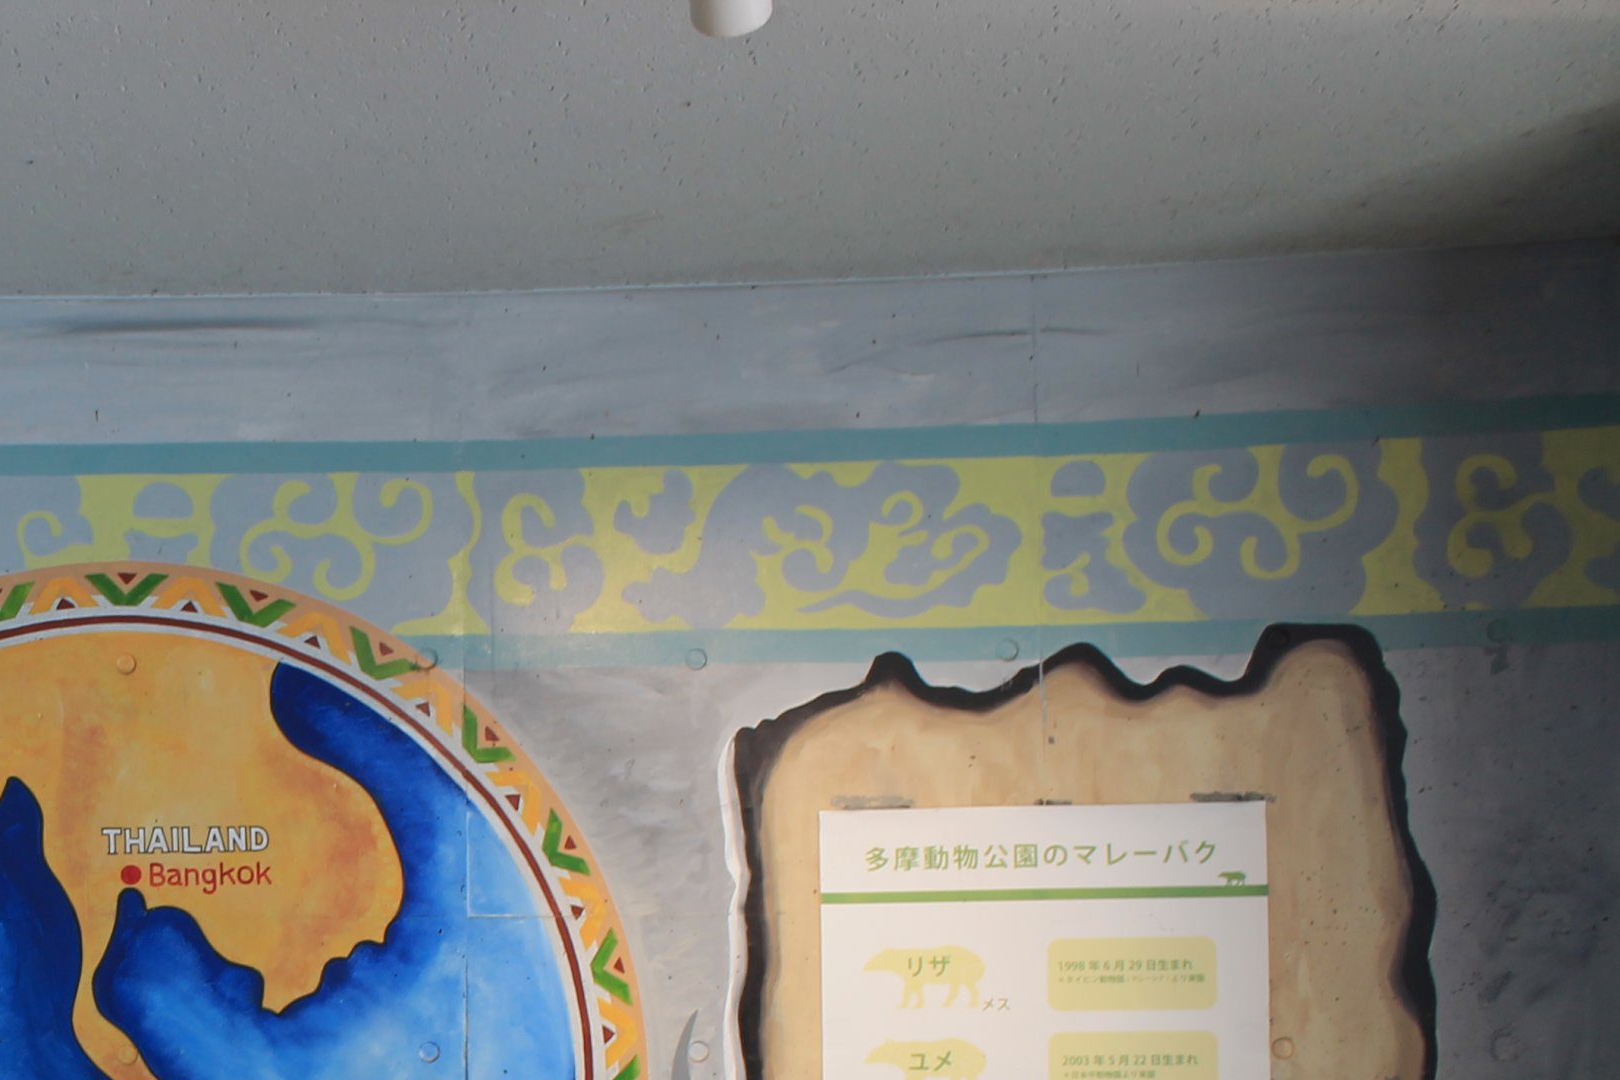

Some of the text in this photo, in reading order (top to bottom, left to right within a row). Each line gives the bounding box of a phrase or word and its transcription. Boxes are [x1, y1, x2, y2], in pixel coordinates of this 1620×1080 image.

[102, 826, 269, 854] THAILAND
[864, 841, 1217, 872] 多摩動物公園のマレーバク
[149, 862, 272, 894] Bangkok
[908, 955, 951, 977] リザ
[982, 998, 1011, 1011] メス
[909, 1051, 953, 1072] ユメ
